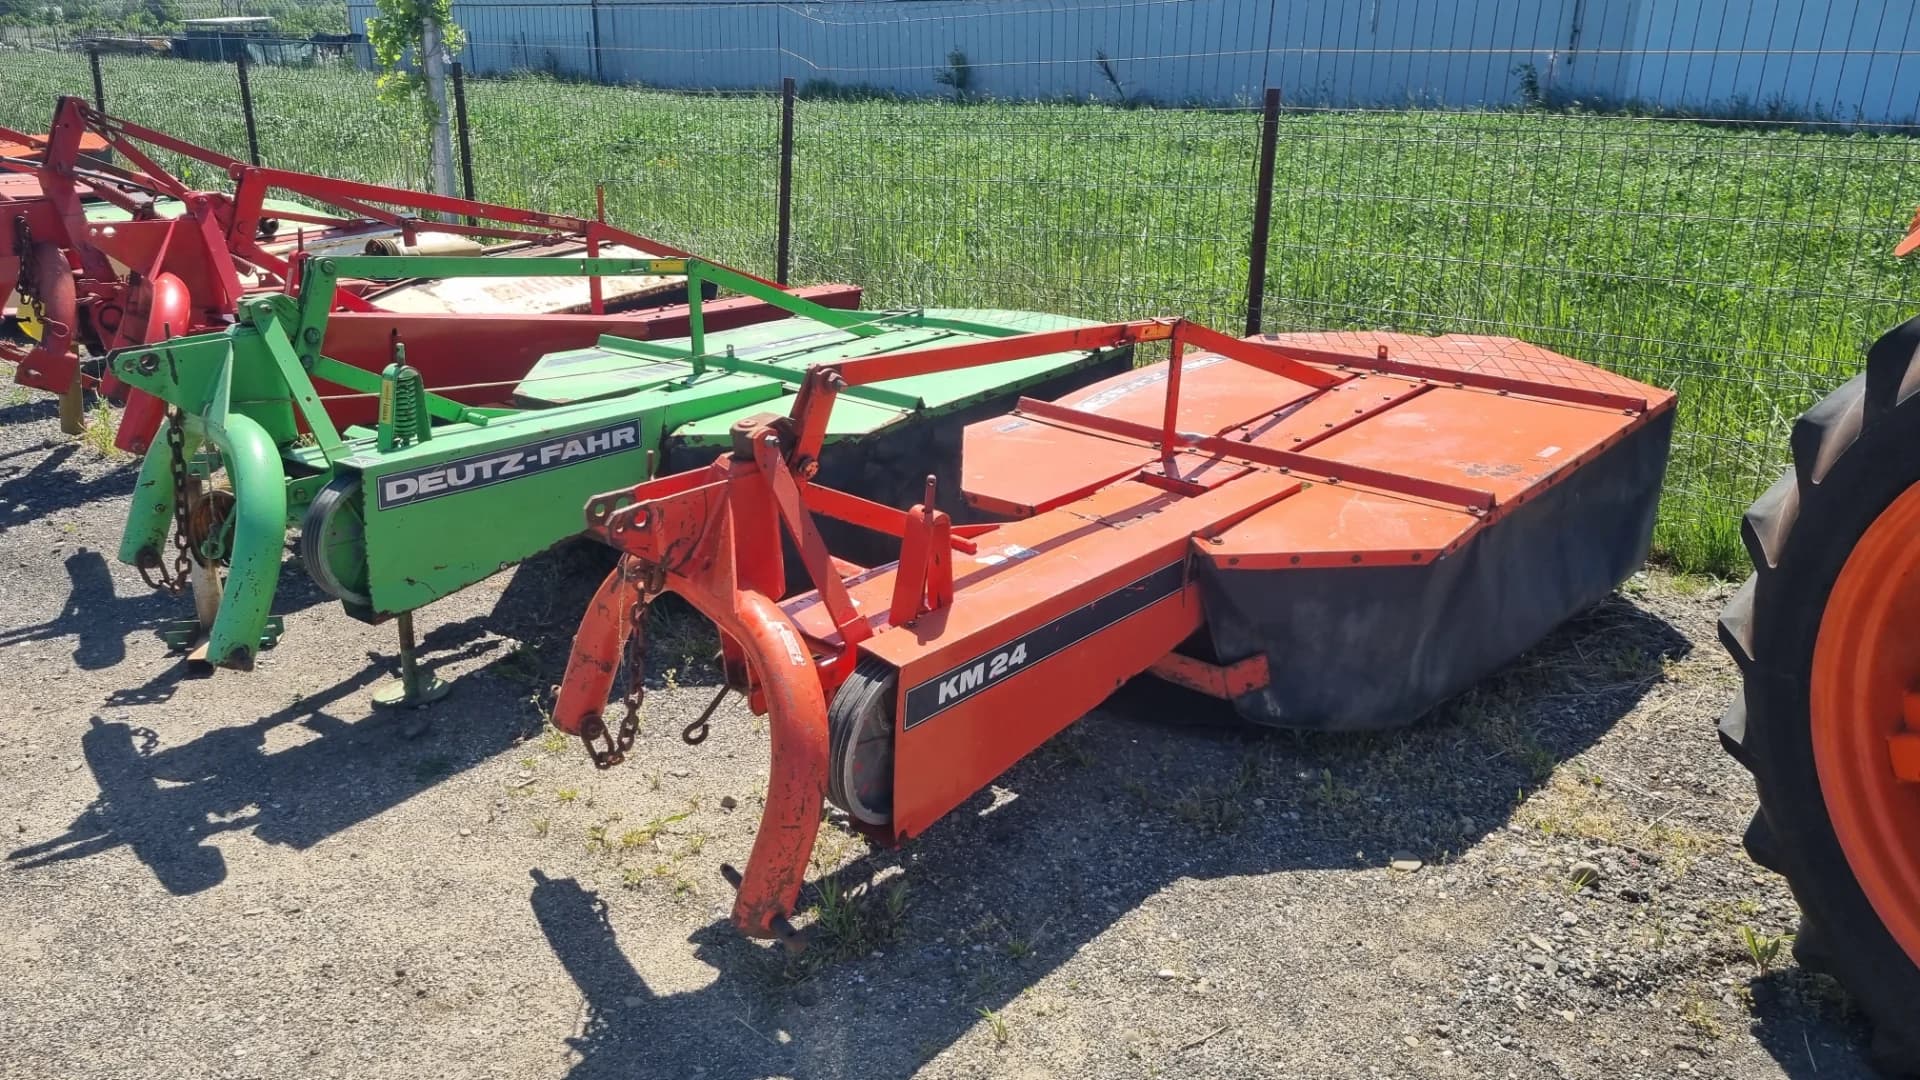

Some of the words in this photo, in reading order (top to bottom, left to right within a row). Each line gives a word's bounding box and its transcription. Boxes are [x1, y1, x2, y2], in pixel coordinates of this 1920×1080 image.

[385, 425, 637, 503] DEUTZ-FAHR
[938, 662, 984, 705] KM
[989, 642, 1027, 679] 24
